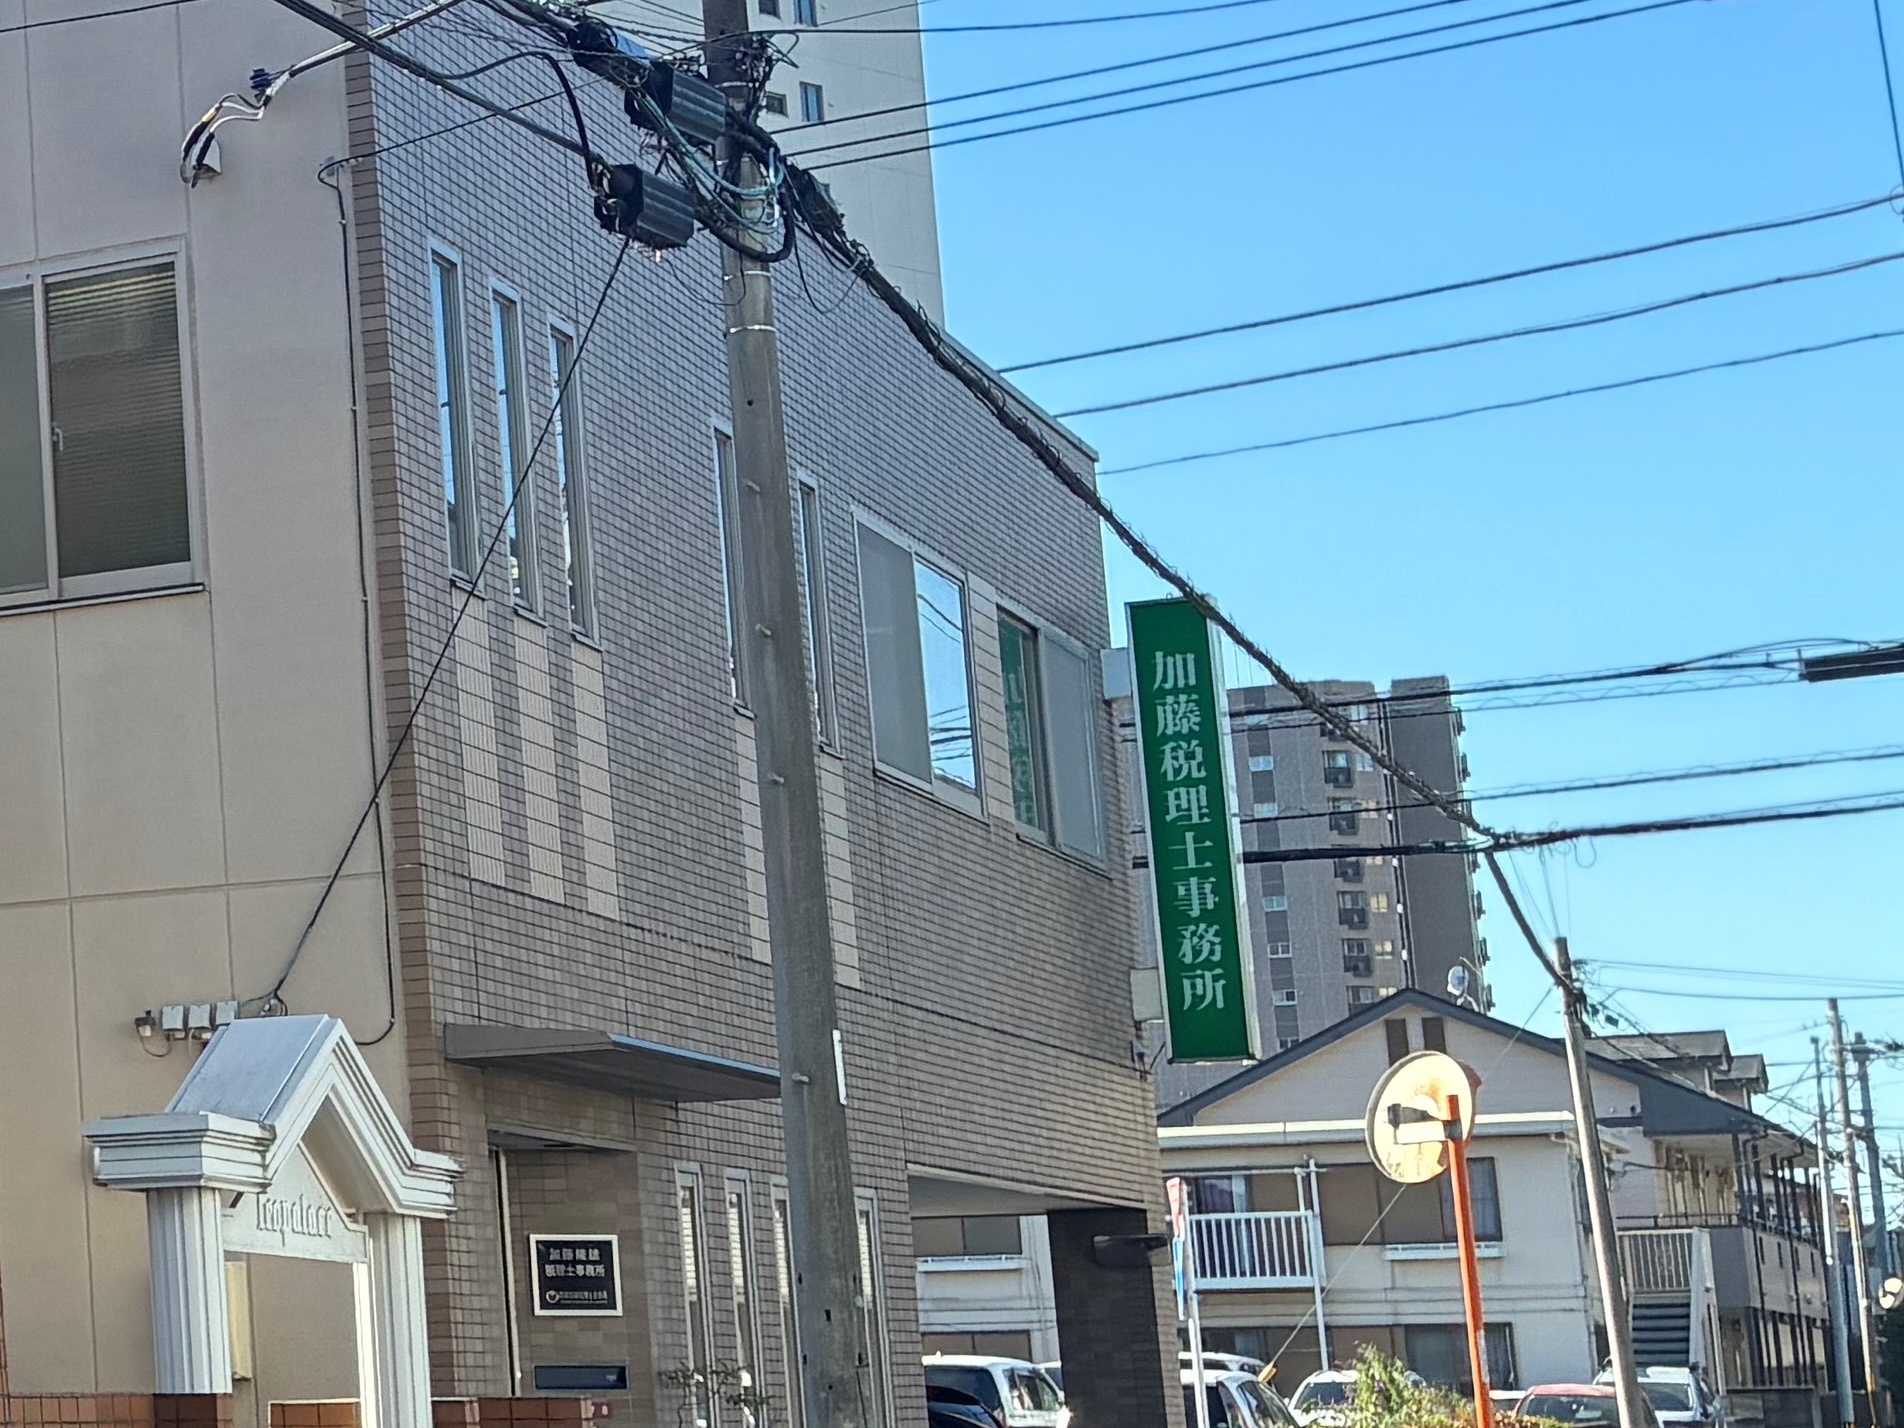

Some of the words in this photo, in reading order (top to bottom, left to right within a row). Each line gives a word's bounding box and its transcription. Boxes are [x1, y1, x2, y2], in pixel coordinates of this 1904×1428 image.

[1152, 650, 1225, 1011] 加藤税理士事務所
[256, 1192, 332, 1247] Leopalace
